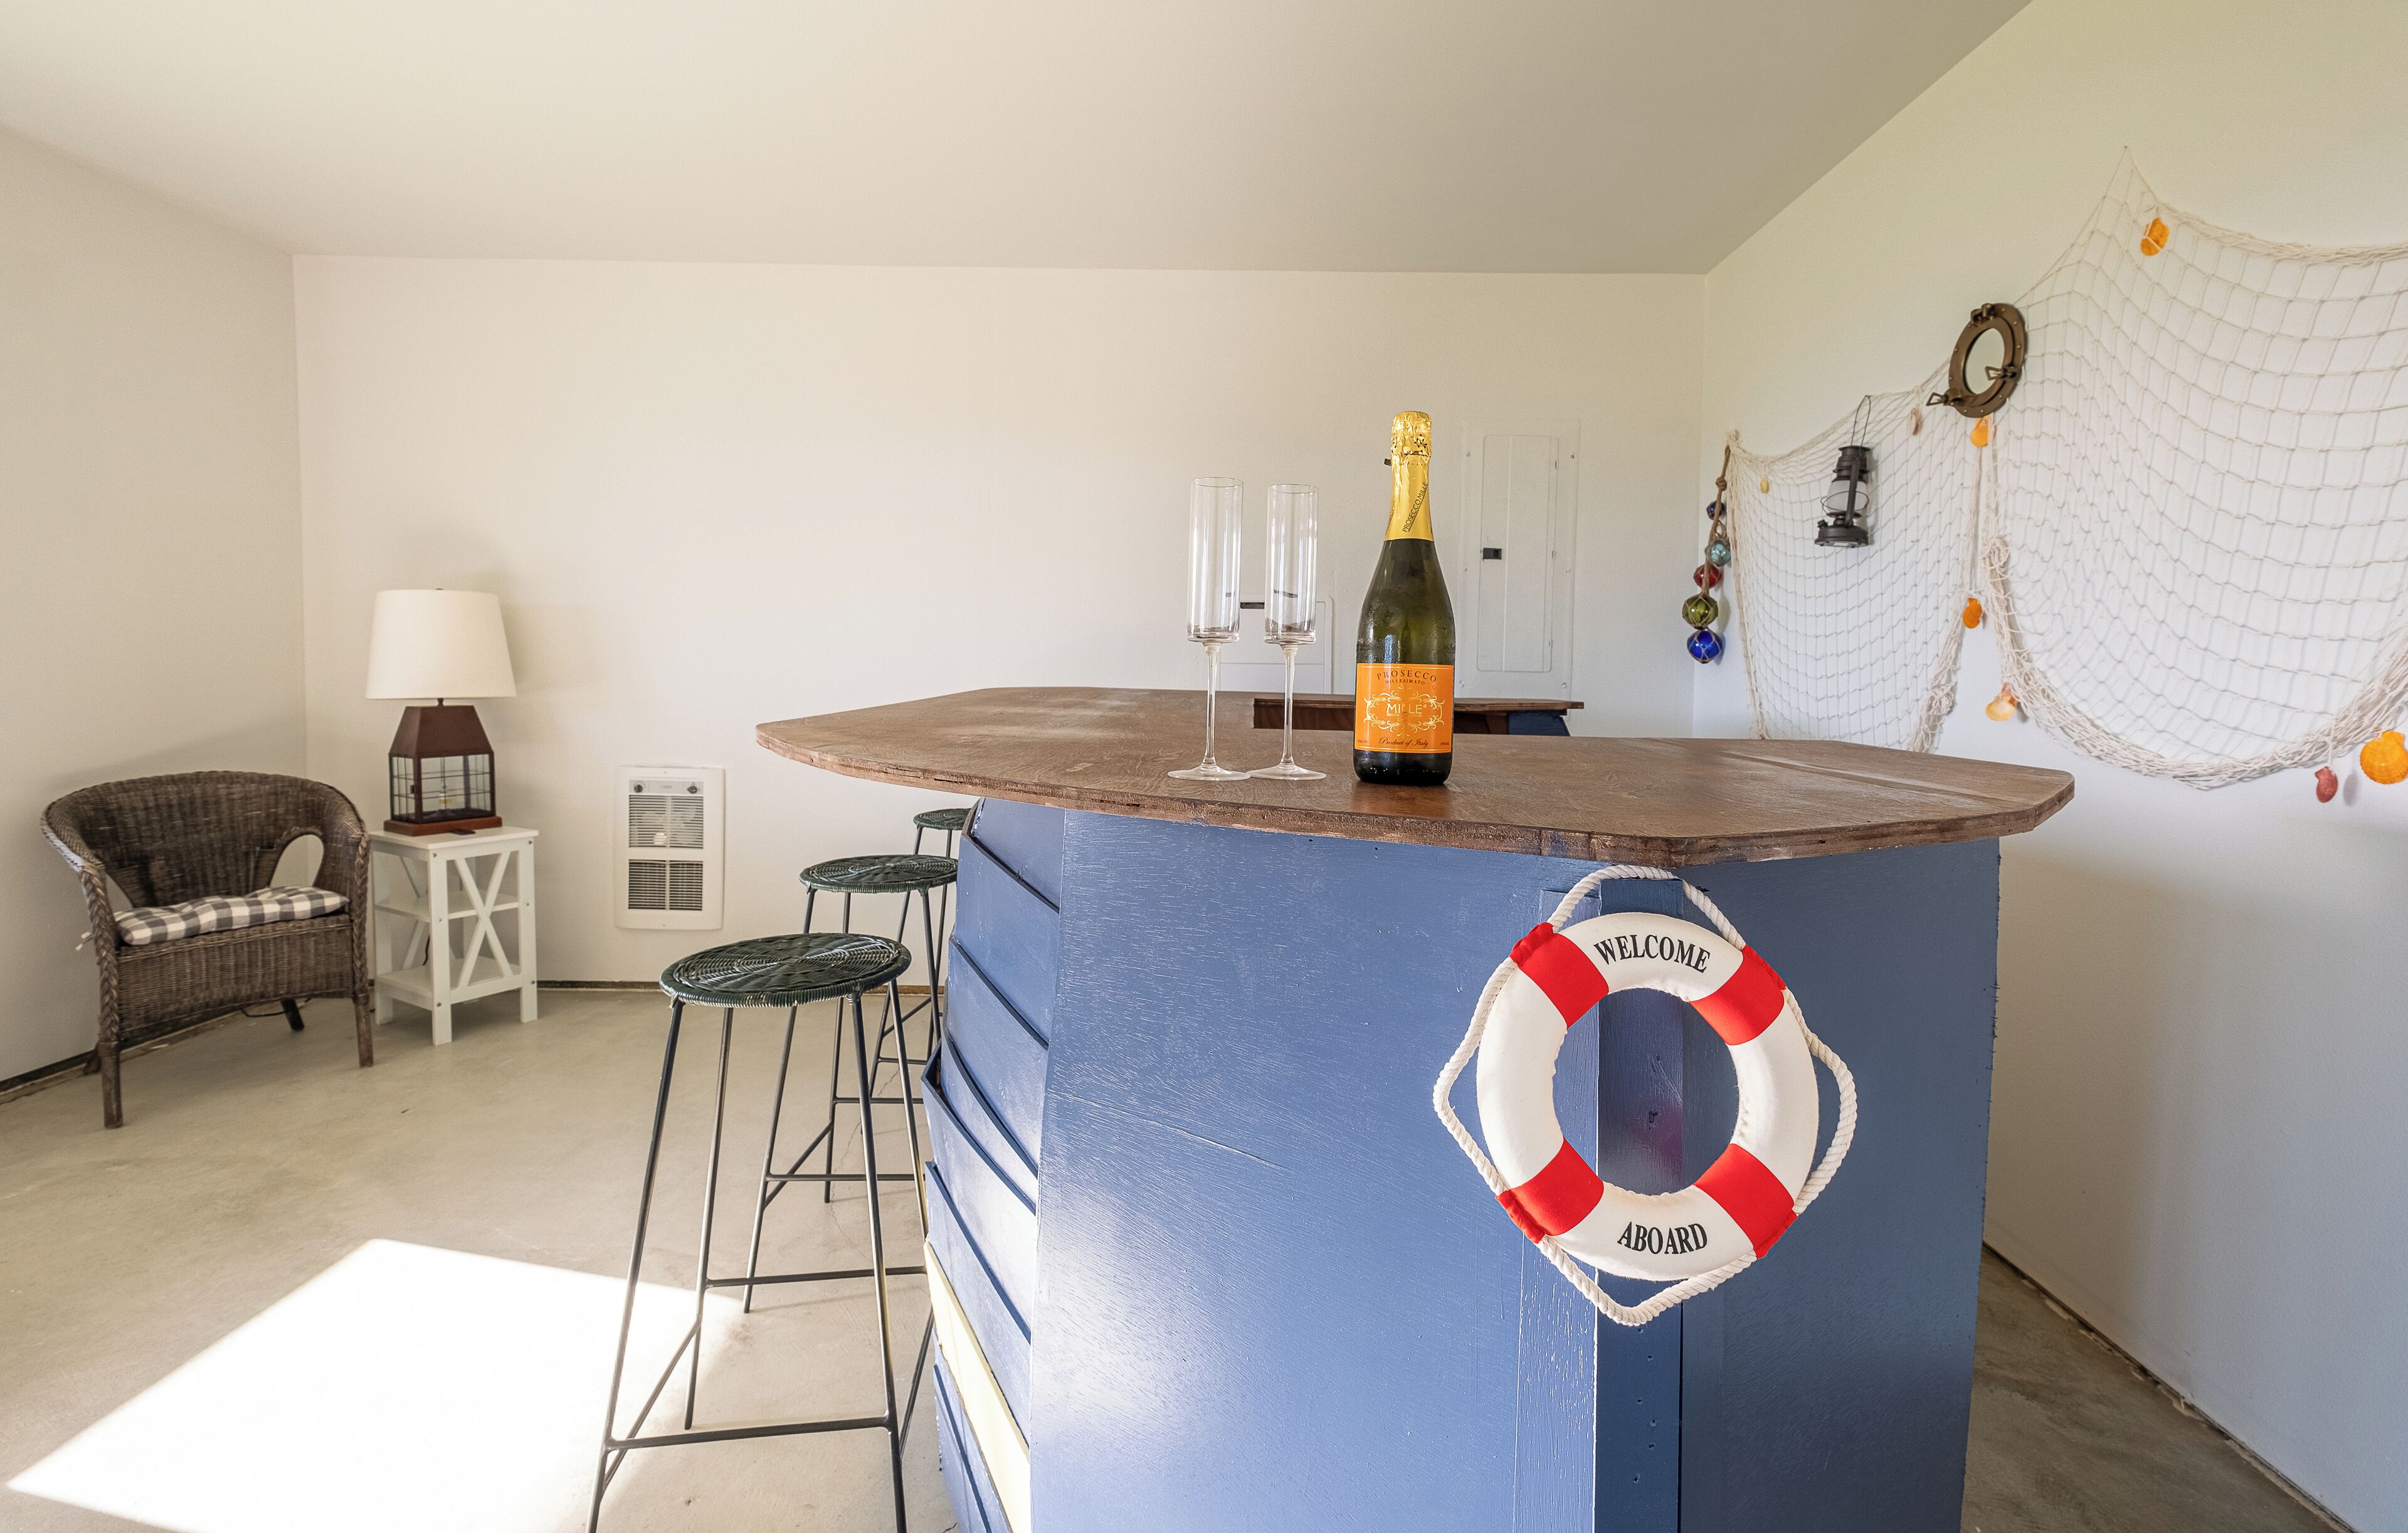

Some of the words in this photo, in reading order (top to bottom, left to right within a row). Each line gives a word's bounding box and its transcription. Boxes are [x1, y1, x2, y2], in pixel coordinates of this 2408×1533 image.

[1402, 499, 1420, 532] PROSECCO
[1377, 670, 1437, 682] PROSECCO
[1378, 737, 1404, 745] Product
[1405, 740, 1412, 748] of
[1413, 738, 1428, 748] Italy
[1594, 934, 1710, 973] WELCOME
[1617, 1221, 1708, 1255] ABOARD
